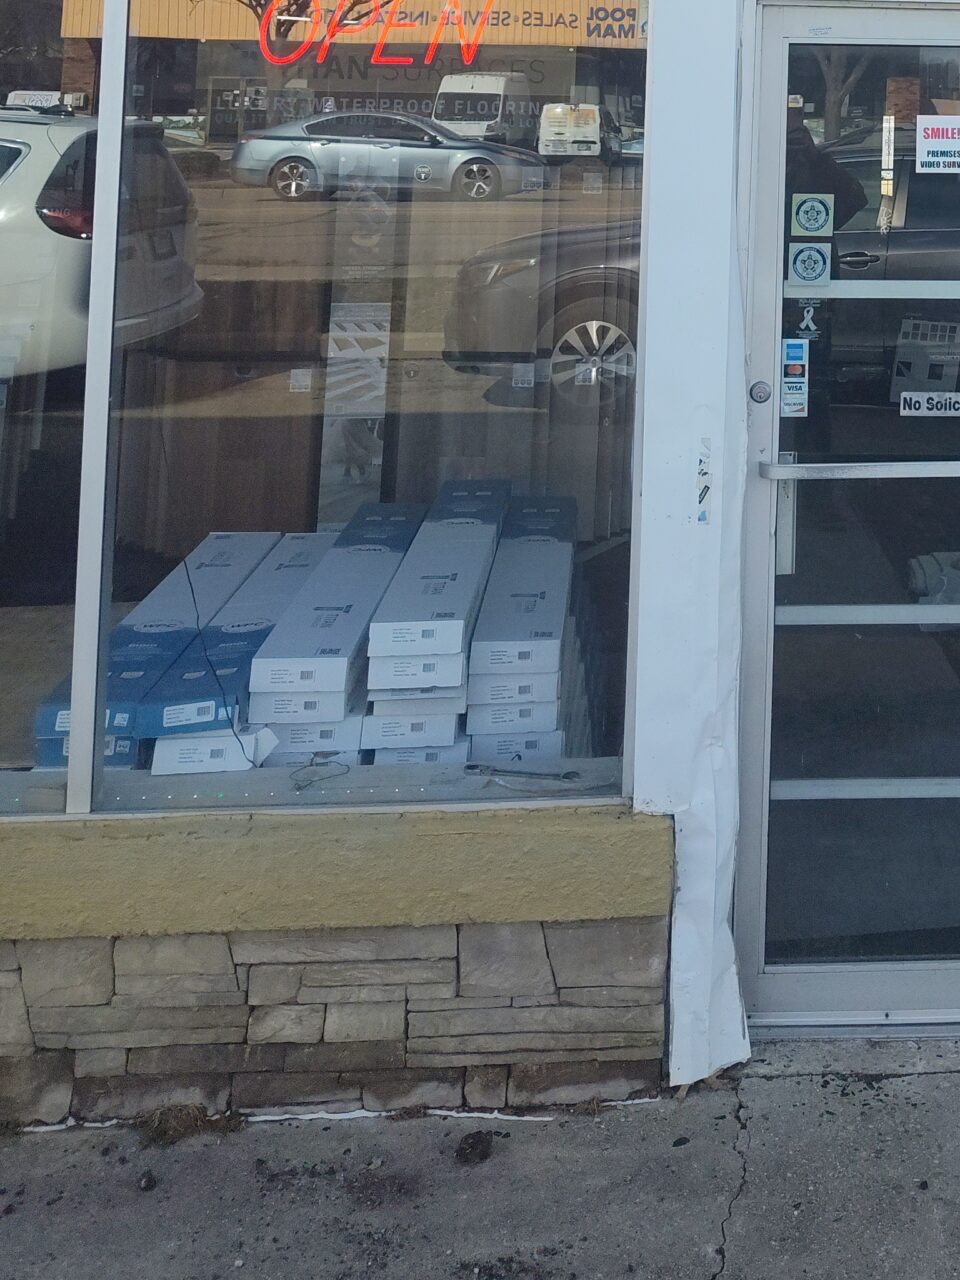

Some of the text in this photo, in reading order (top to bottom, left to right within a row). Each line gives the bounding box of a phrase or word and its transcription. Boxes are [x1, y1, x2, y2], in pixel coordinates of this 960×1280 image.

[454, 100, 542, 116] FLOORIN
[922, 126, 960, 141] SMILE!
[926, 149, 960, 159] PREMISES
[919, 160, 941, 169] VIDEO
[787, 384, 803, 392] VISA
[902, 397, 924, 413] No
